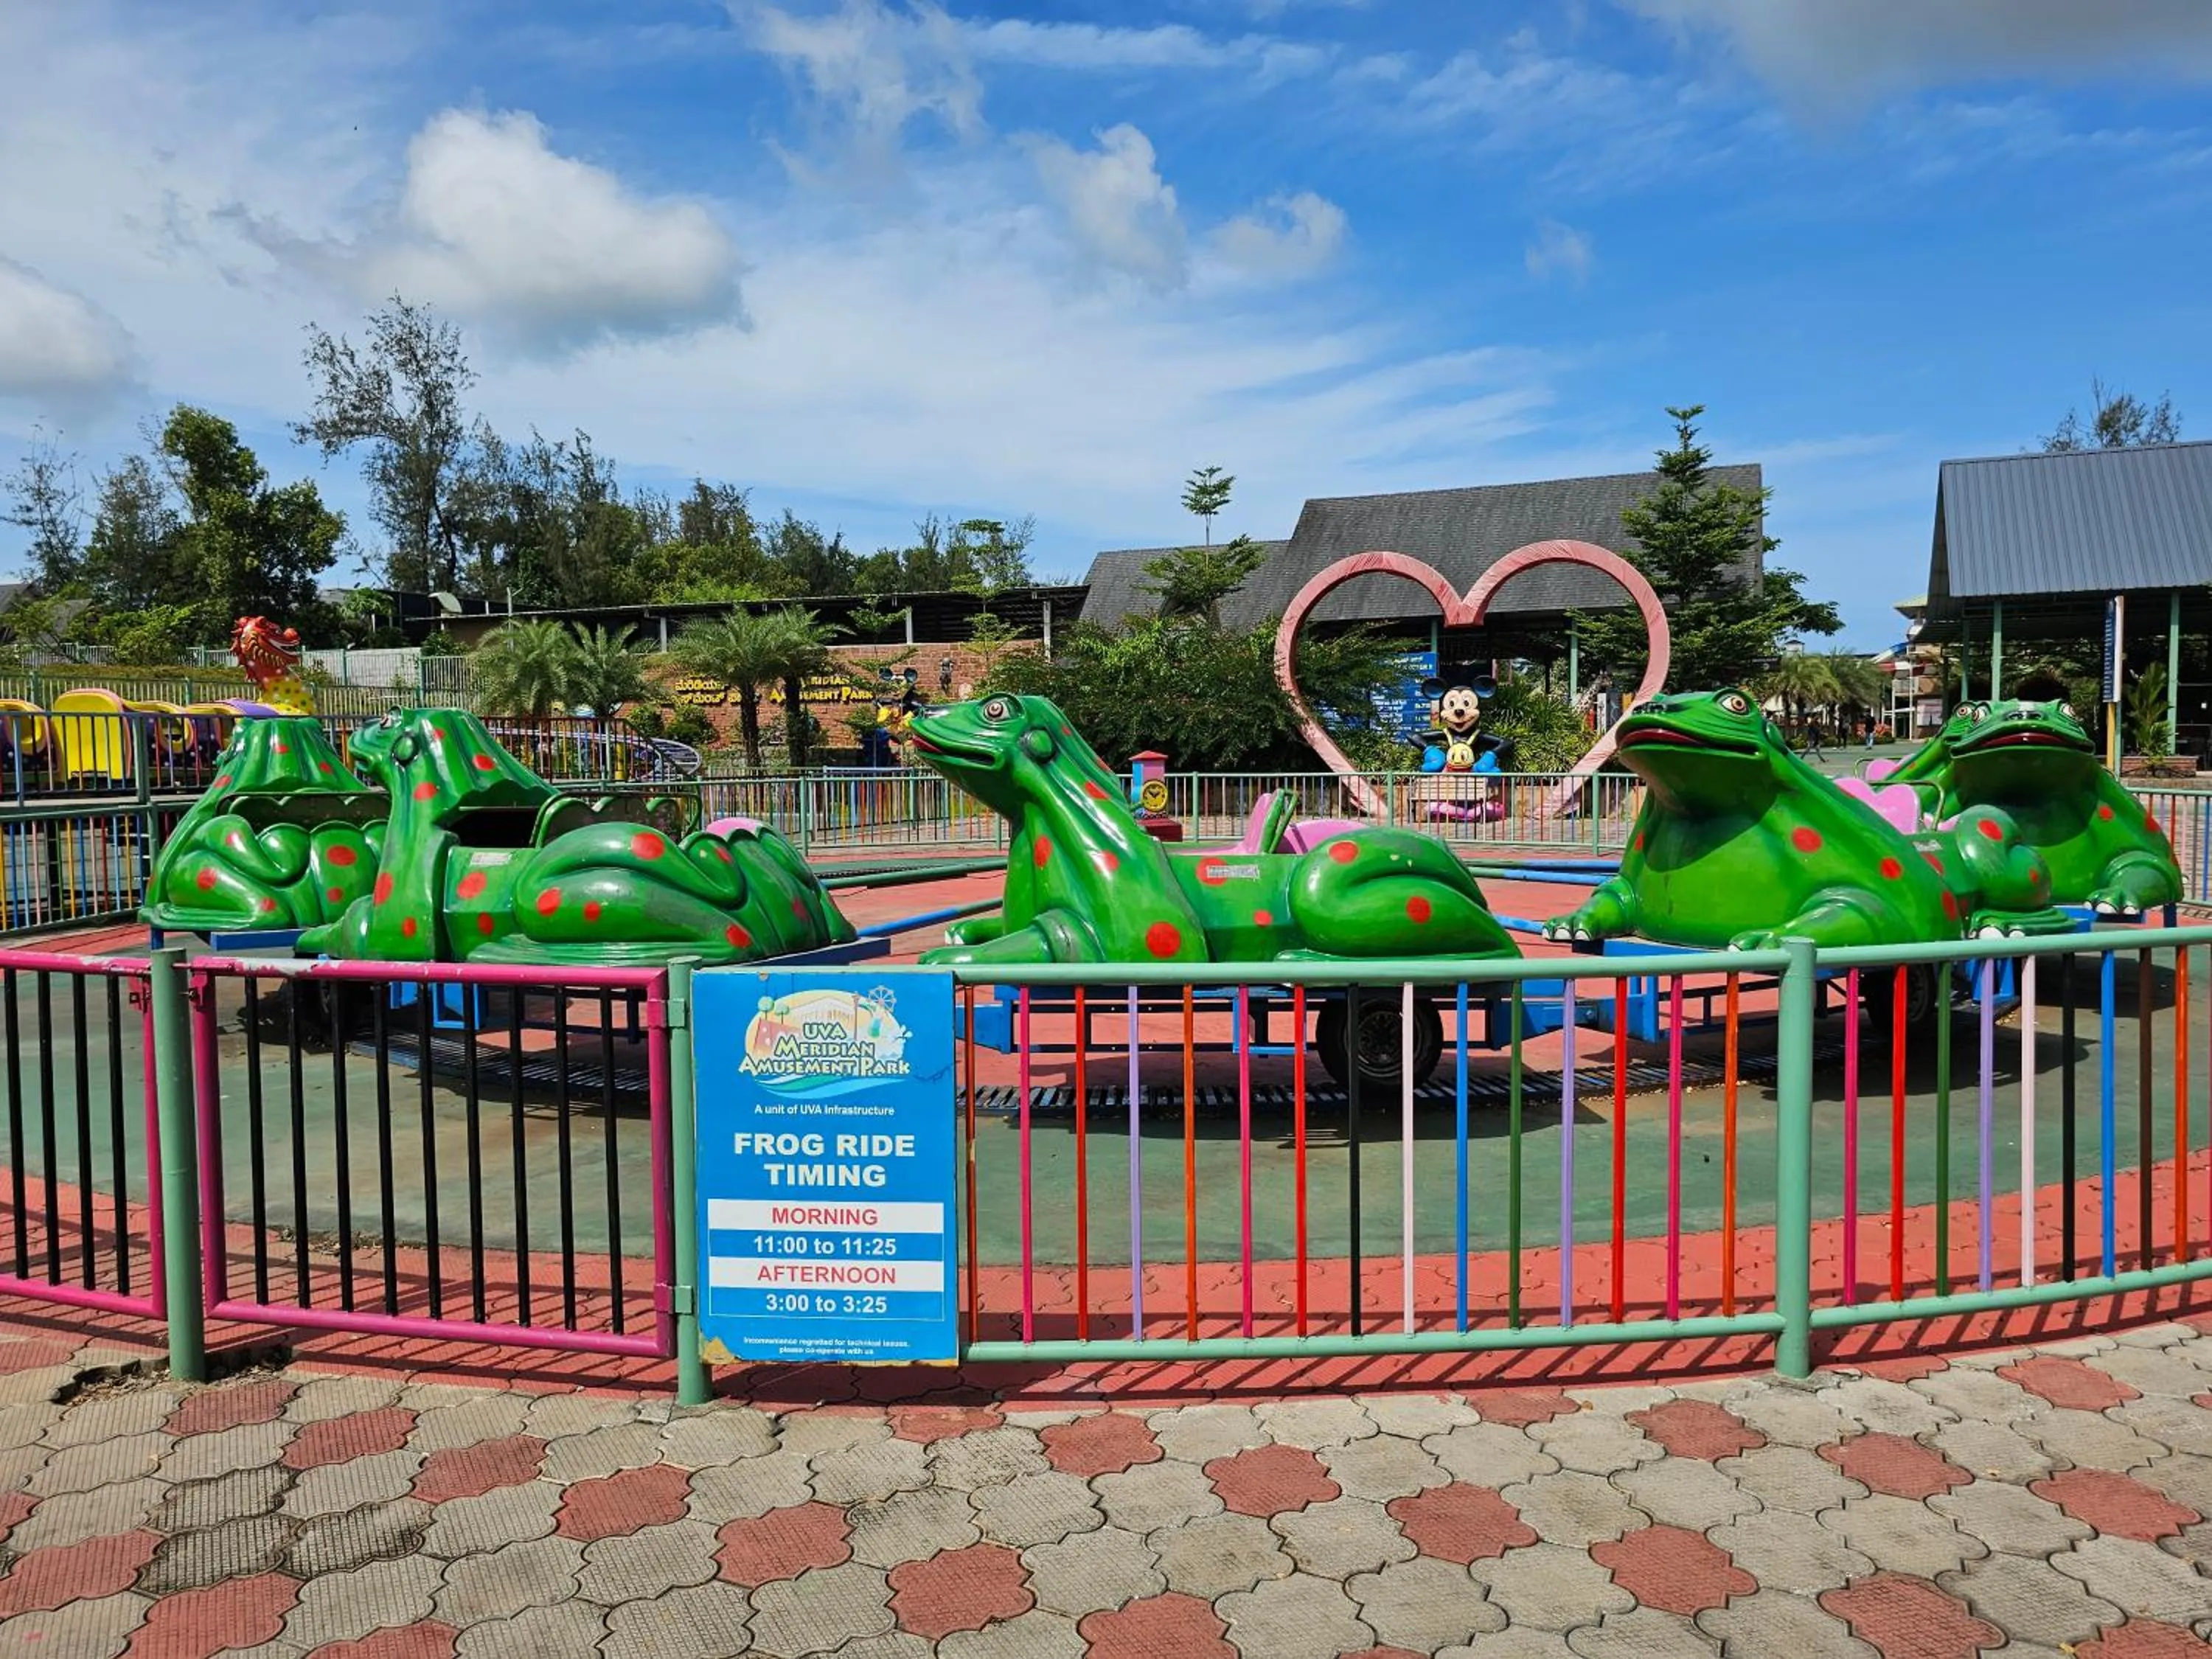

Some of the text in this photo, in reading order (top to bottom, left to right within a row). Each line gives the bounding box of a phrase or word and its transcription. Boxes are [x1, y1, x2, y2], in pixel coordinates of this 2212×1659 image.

[769, 688, 840, 703] ASEMENT
[803, 1022, 847, 1040] UVA
[775, 1034, 875, 1060] MERIDIAN
[738, 1053, 911, 1077] AMUSEMENT PARK
[754, 1105, 895, 1116] A unit of UVA Infrastructure
[734, 1133, 915, 1157] FROG RIDE
[764, 1164, 886, 1187] TIMING
[772, 1208, 877, 1225] MORNING
[754, 1236, 897, 1255] 11:00 to 11:25
[757, 1266, 896, 1284] AFTERNOON
[766, 1294, 887, 1313] 3:00 to 3:25
